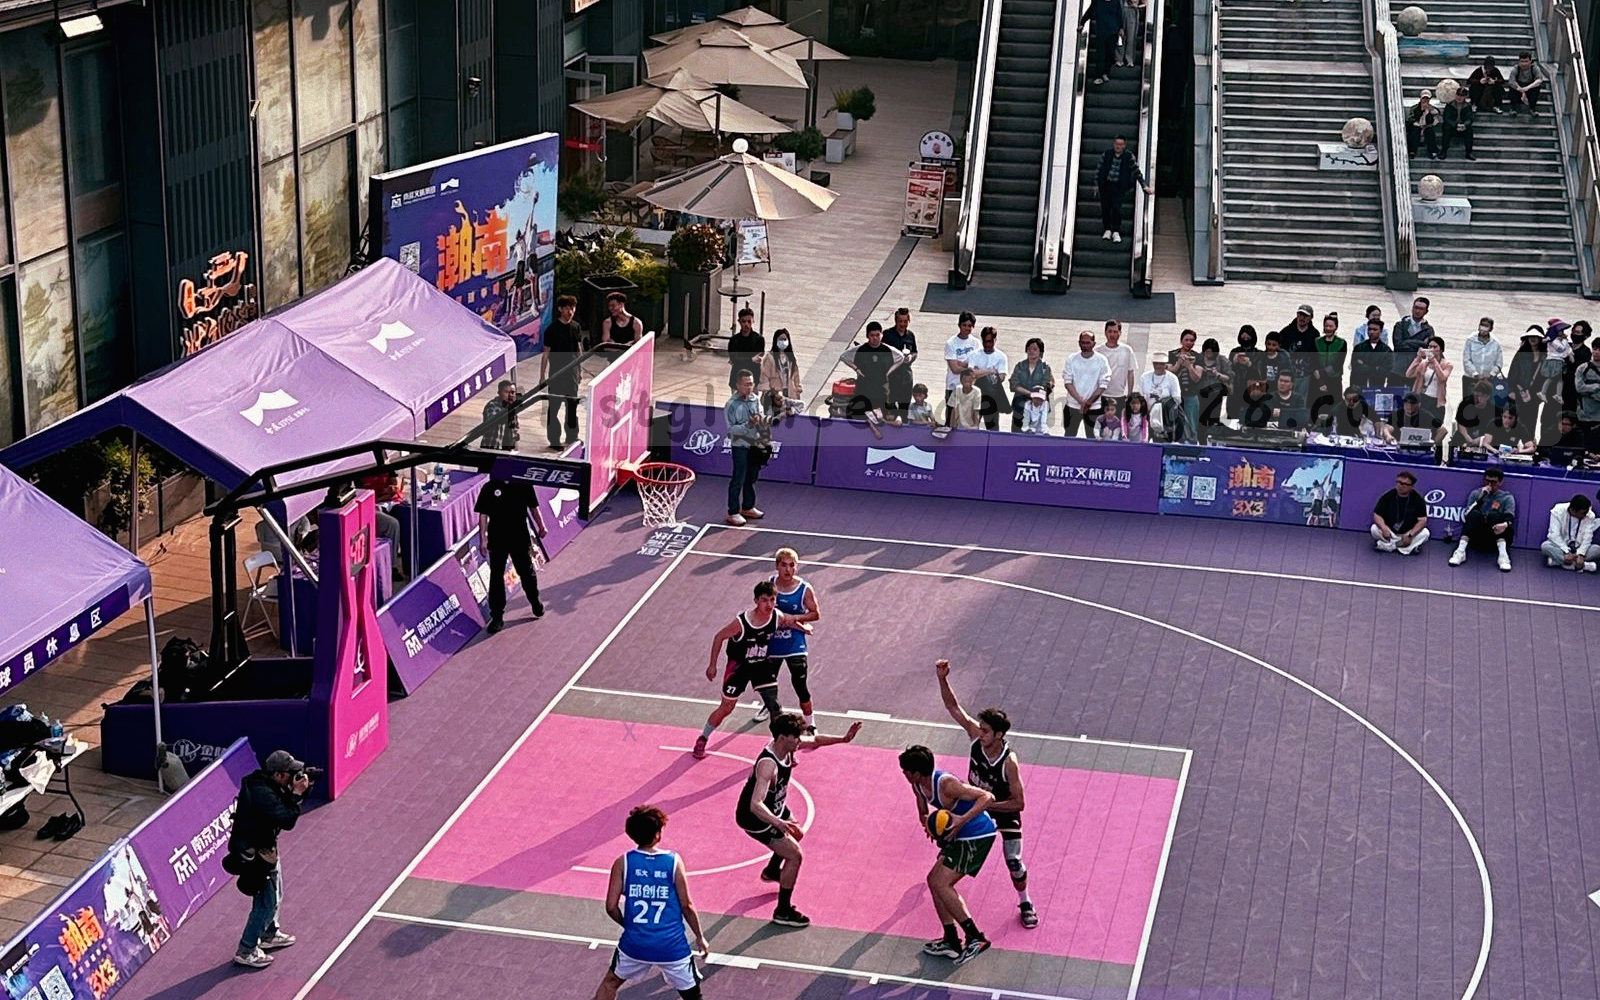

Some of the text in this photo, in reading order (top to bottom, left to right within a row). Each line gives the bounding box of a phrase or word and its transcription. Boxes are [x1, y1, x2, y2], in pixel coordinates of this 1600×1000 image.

[1046, 465, 1132, 482] 南京文旅集团
[417, 594, 460, 637] 南京文旅集团
[629, 884, 669, 899] 邱创佳
[632, 899, 667, 924] 27
